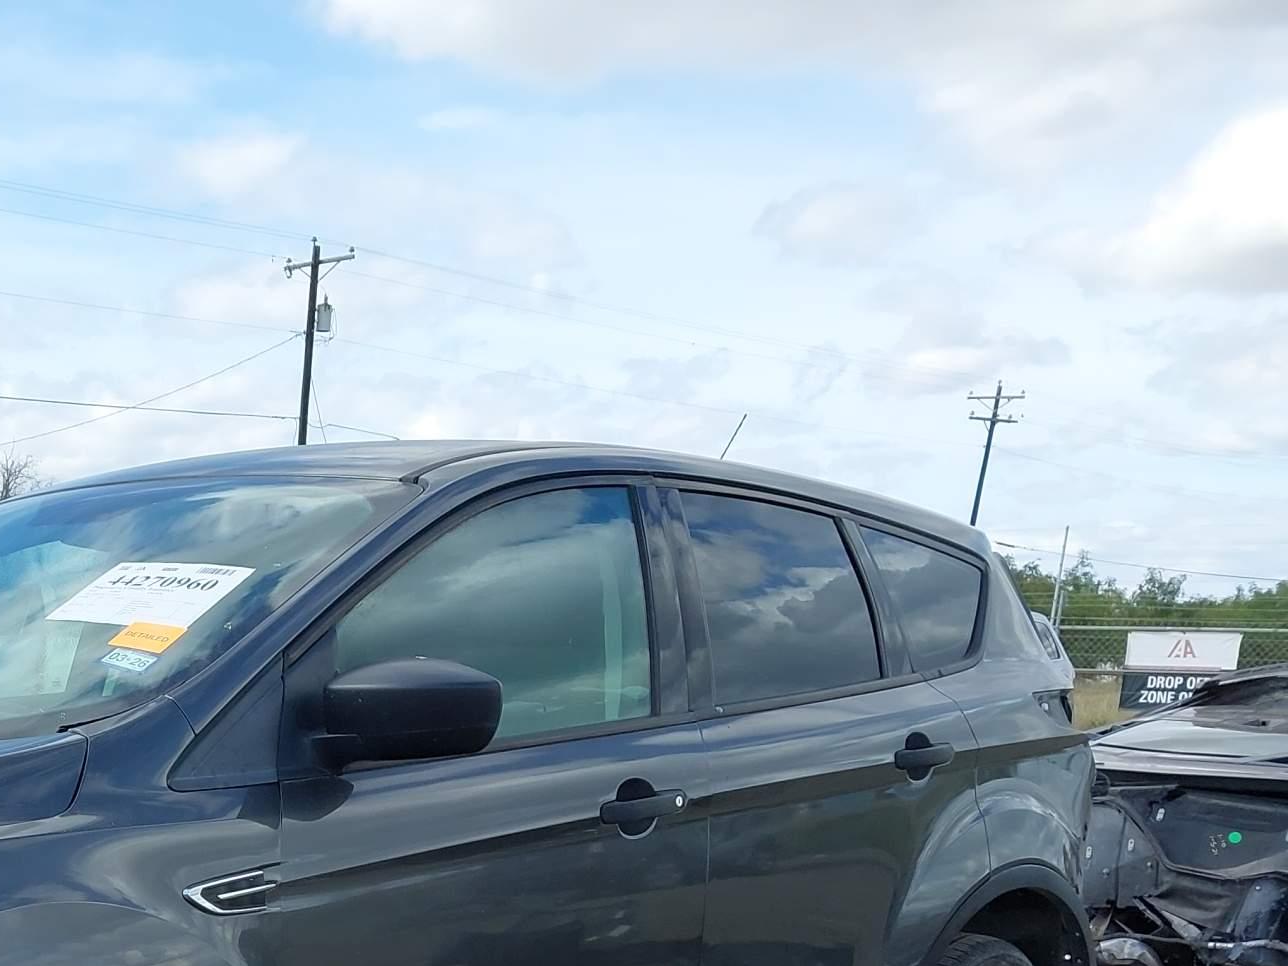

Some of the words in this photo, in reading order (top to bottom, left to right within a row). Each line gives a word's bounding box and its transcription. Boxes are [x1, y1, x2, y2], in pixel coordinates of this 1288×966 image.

[108, 575, 219, 591] 44270960
[124, 631, 170, 643] DETAILED
[1147, 675, 1184, 689] DROP
[1139, 690, 1176, 704] ZONE
